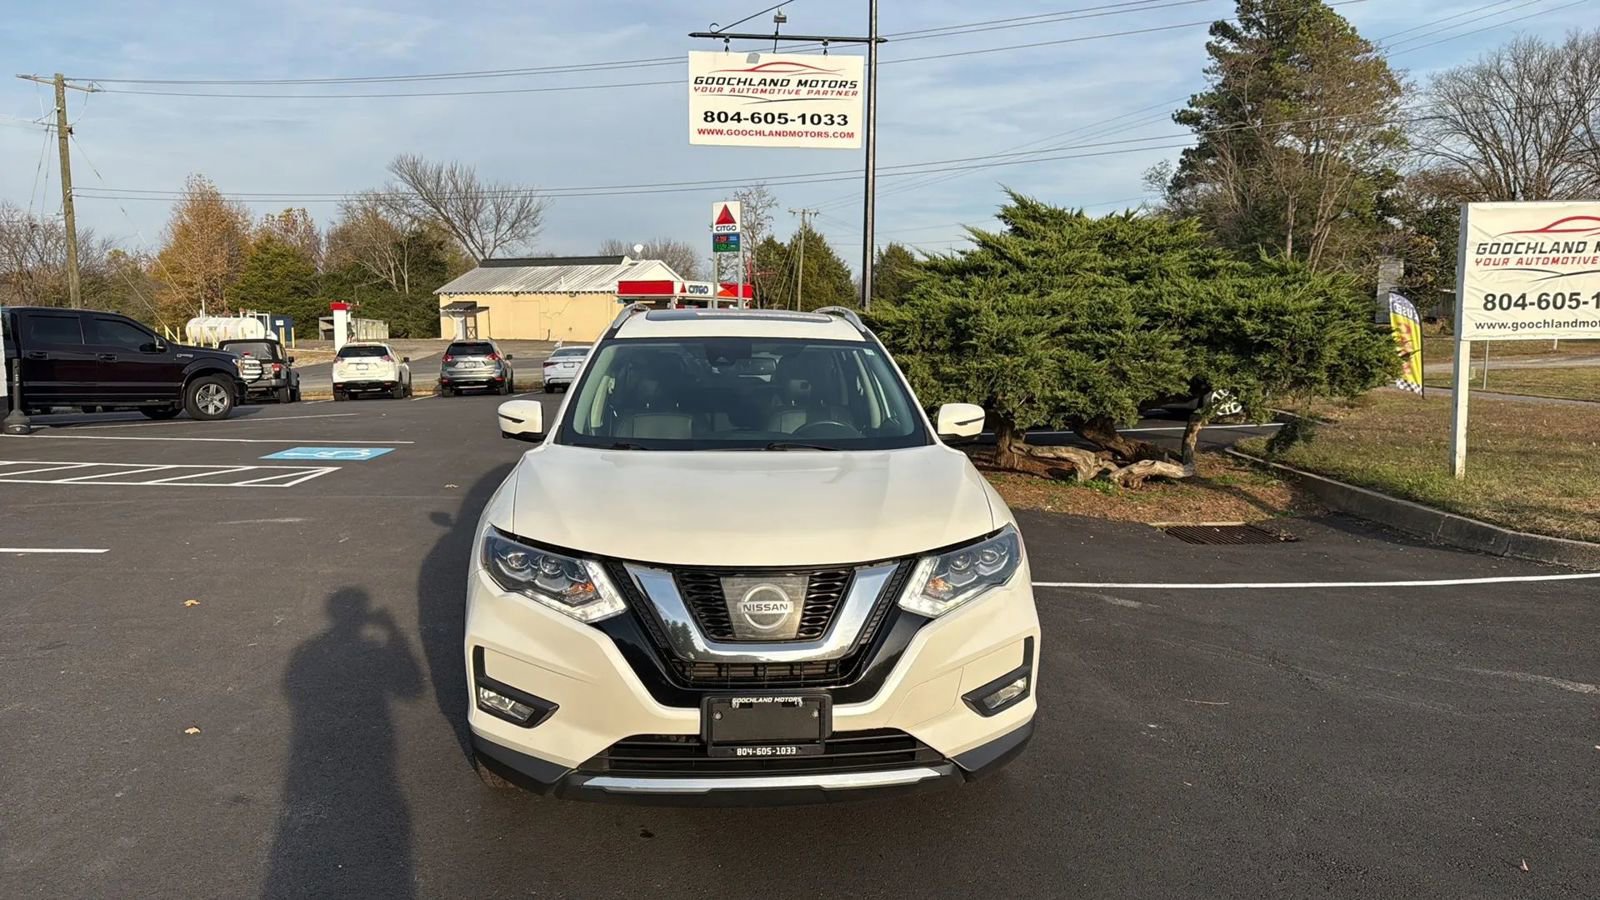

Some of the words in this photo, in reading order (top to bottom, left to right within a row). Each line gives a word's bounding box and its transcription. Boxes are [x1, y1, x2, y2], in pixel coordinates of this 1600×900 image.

[693, 76, 790, 87] GOOCHLAND
[796, 79, 858, 89] MOTORS
[729, 87, 801, 95] AUTOMOTIVE
[806, 89, 858, 97] PARTNER
[703, 110, 848, 126] 804-605-1033
[697, 128, 855, 139] WWW.GOOCHLANDMOTORS.COM
[1475, 241, 1588, 255] GOOCHLAND
[1474, 257, 1510, 267] YOUR
[1516, 256, 1599, 266] AUTOMOTIVE
[688, 284, 709, 295] CITGO
[742, 602, 789, 613] NISSAN
[736, 746, 796, 756] 804-605-1033
